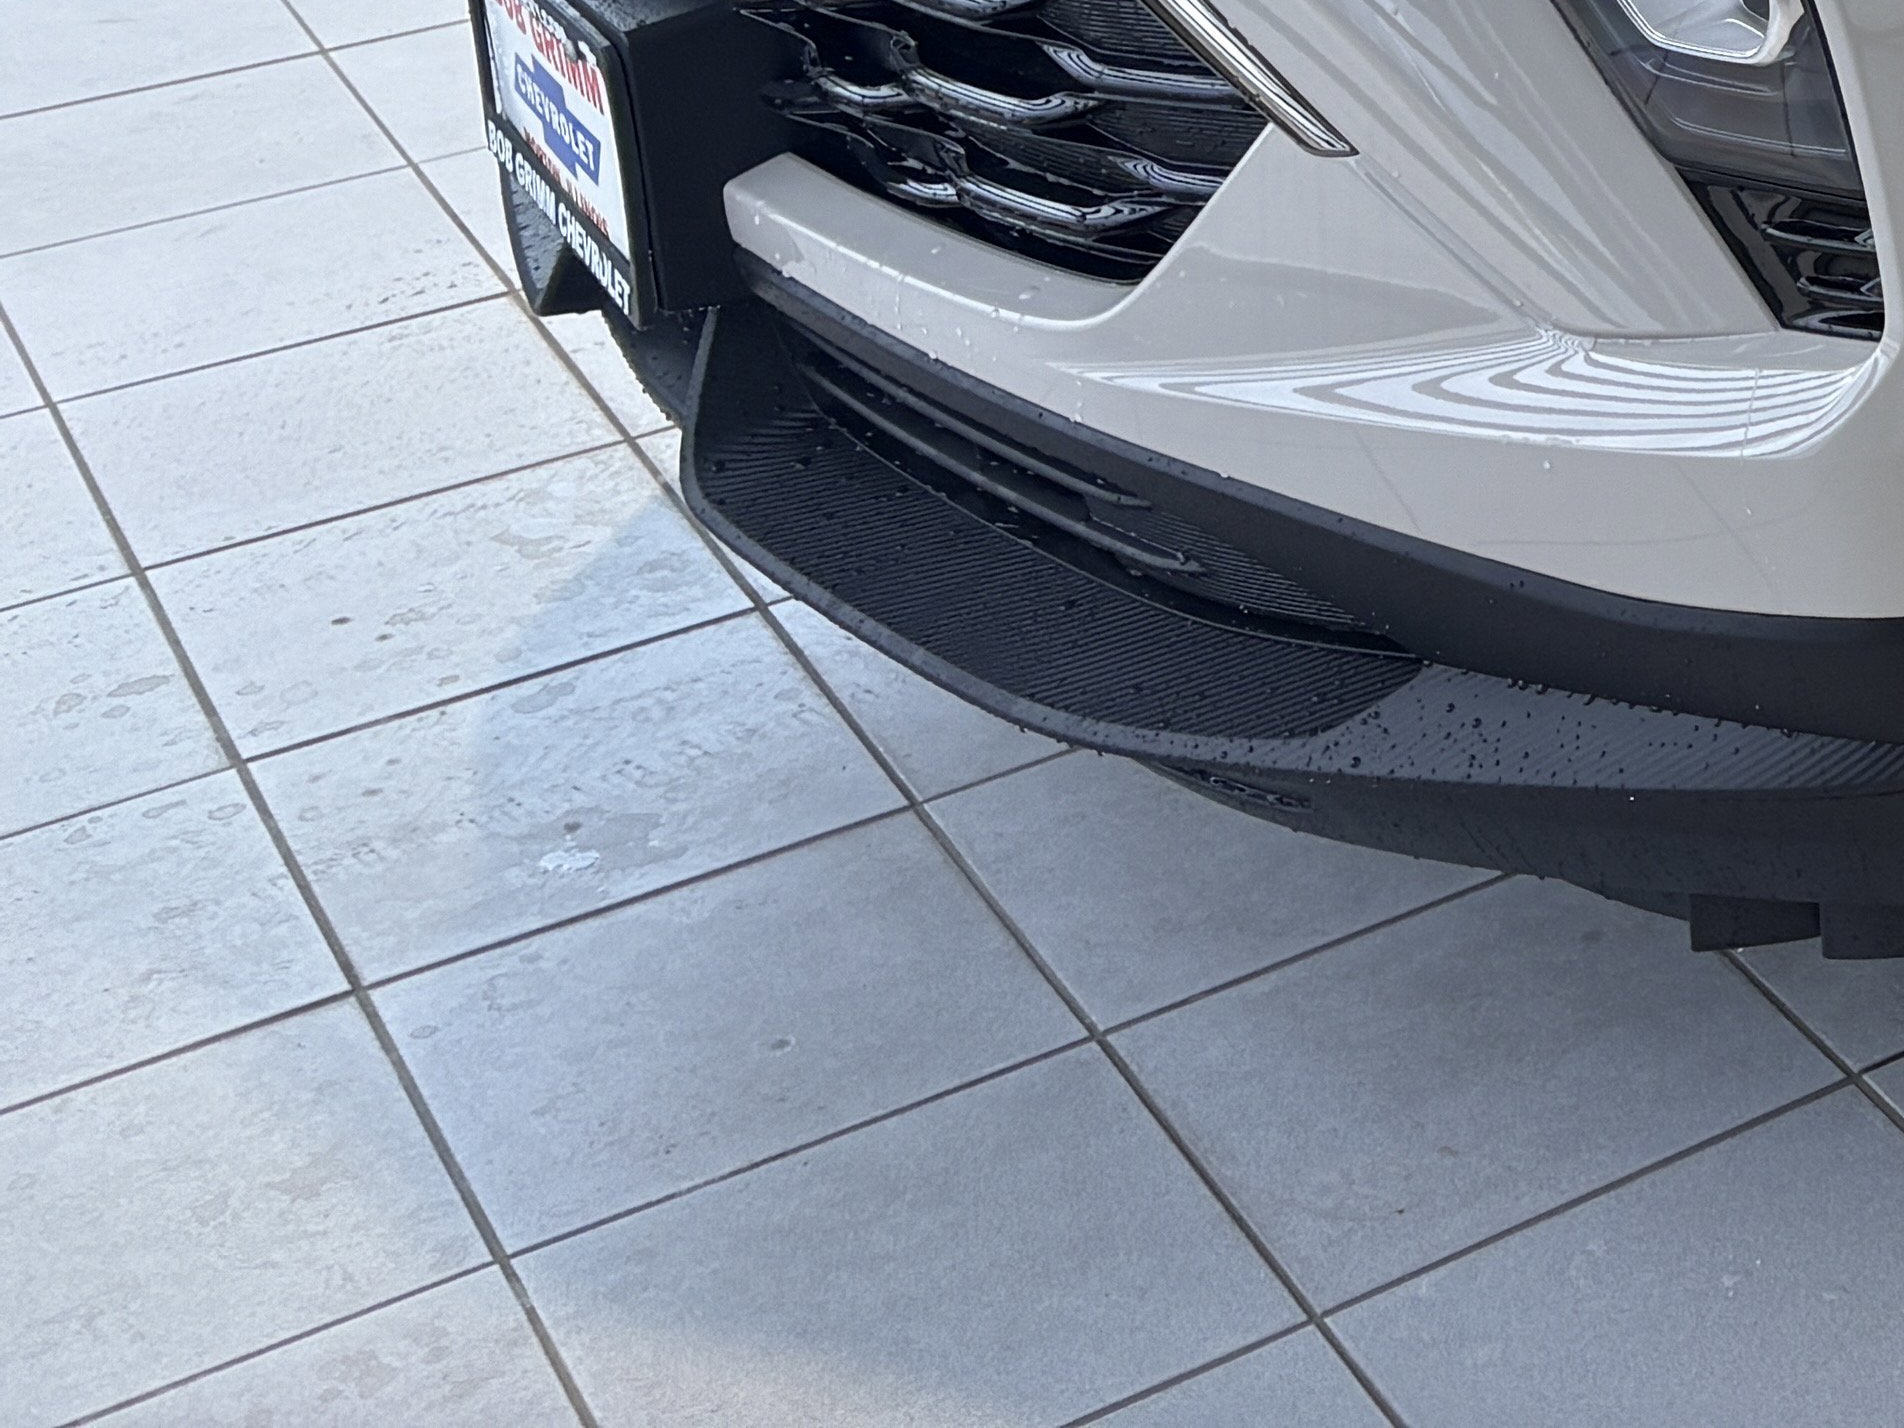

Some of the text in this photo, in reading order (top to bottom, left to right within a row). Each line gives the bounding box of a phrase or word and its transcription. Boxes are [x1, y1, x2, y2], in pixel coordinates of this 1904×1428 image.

[516, 62, 596, 172] CHEVROLET
[487, 119, 631, 316] BOB GRIMM CHEVROLET
